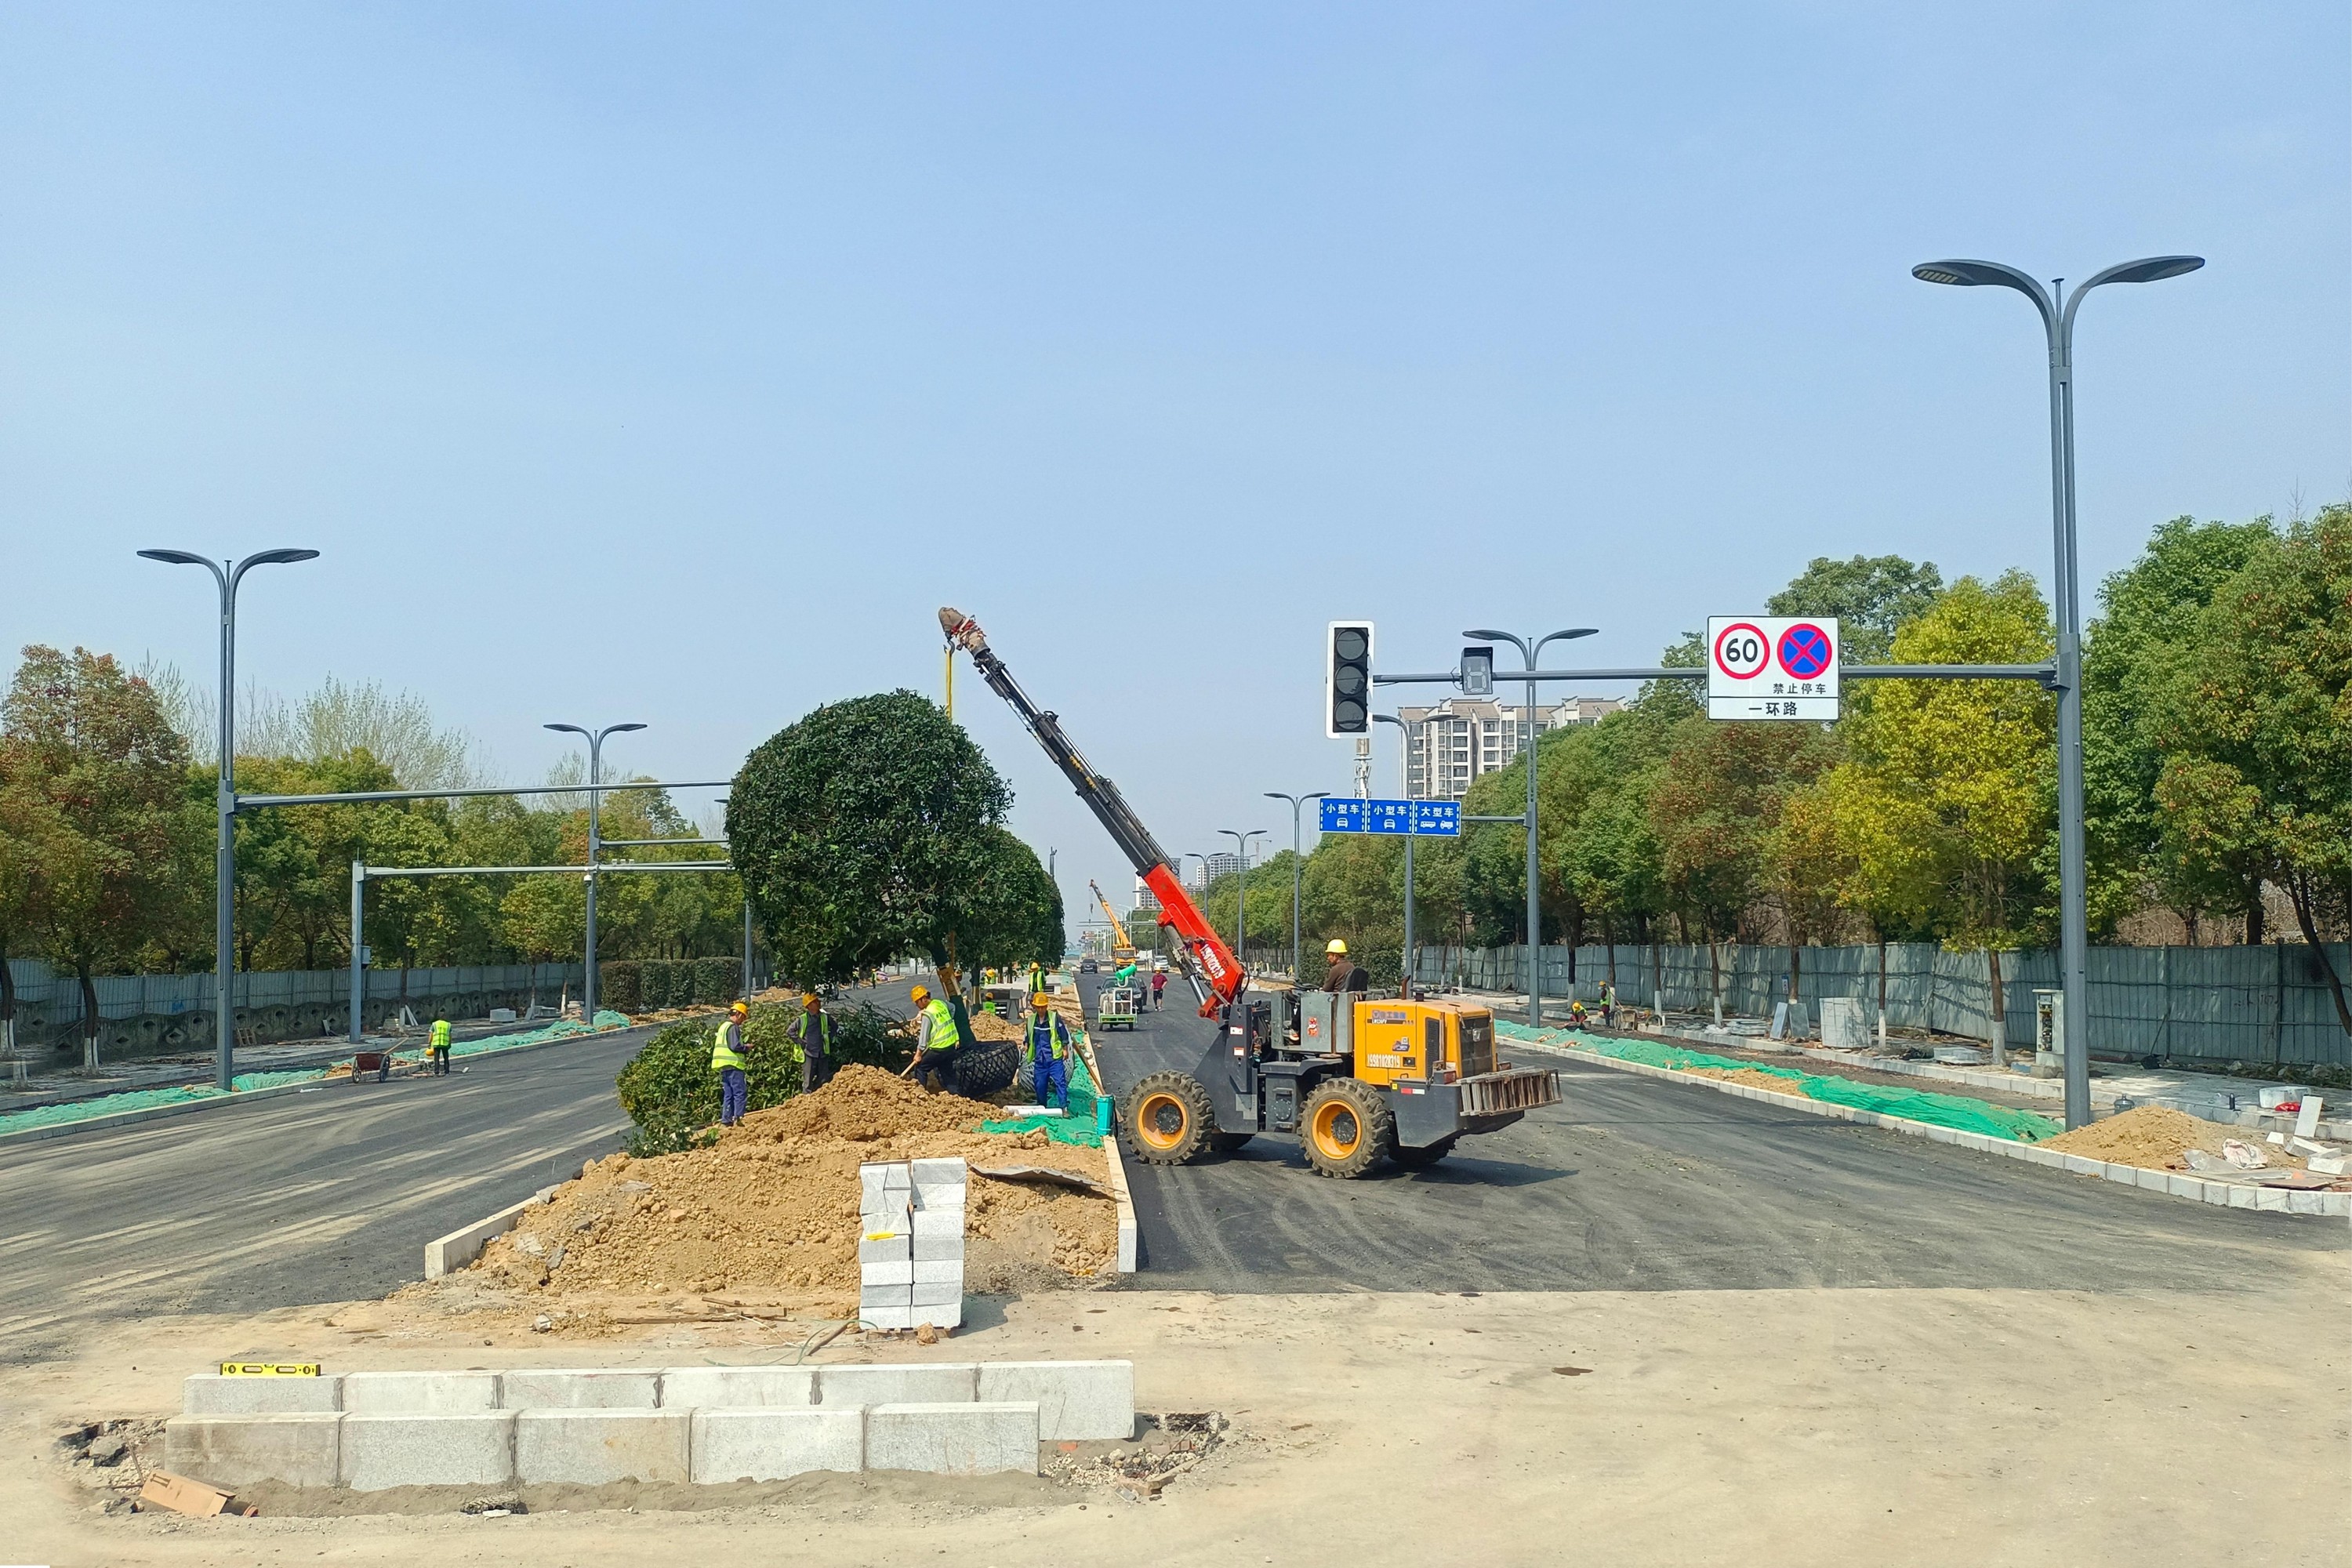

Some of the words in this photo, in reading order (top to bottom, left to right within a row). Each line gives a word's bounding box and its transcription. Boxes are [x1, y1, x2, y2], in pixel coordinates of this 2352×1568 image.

[1726, 637, 1759, 663] 60
[1773, 683, 1827, 695] 禁止停车
[1748, 701, 1798, 717] 一环路
[1326, 804, 1359, 815] 小型车
[1374, 804, 1407, 816] 小型车
[1421, 806, 1454, 818] 大型车
